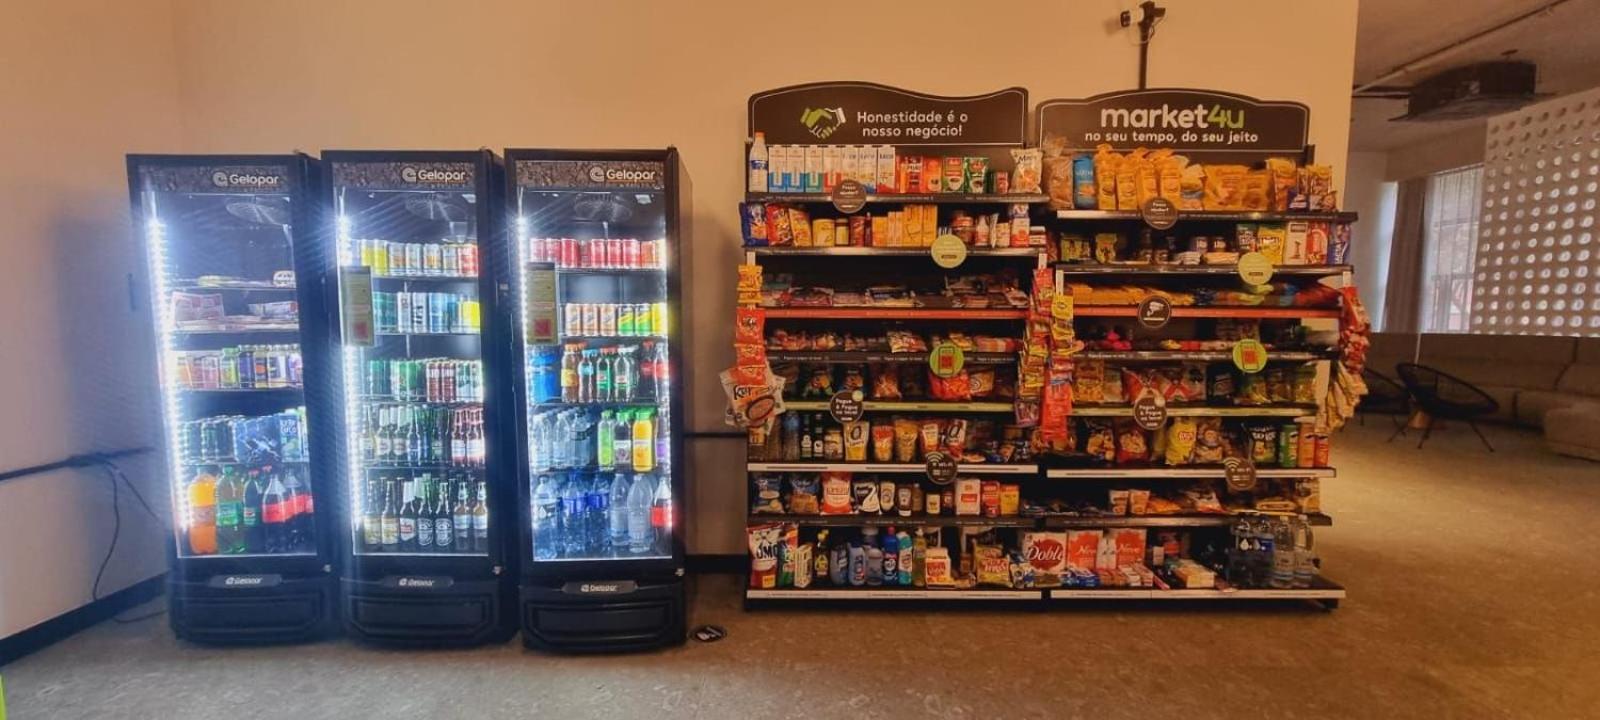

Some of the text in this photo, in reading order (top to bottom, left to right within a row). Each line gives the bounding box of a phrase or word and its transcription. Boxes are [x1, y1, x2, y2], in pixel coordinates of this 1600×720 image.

[857, 110, 968, 123] Honestidade é o
[1101, 103, 1245, 129] market4u
[862, 124, 962, 139] nosso negócio!
[1085, 131, 1259, 144] no seu tempo, do seu jeito
[229, 173, 280, 188] Gelopar
[418, 169, 466, 183] Gelopar
[606, 168, 656, 183] Gelopar
